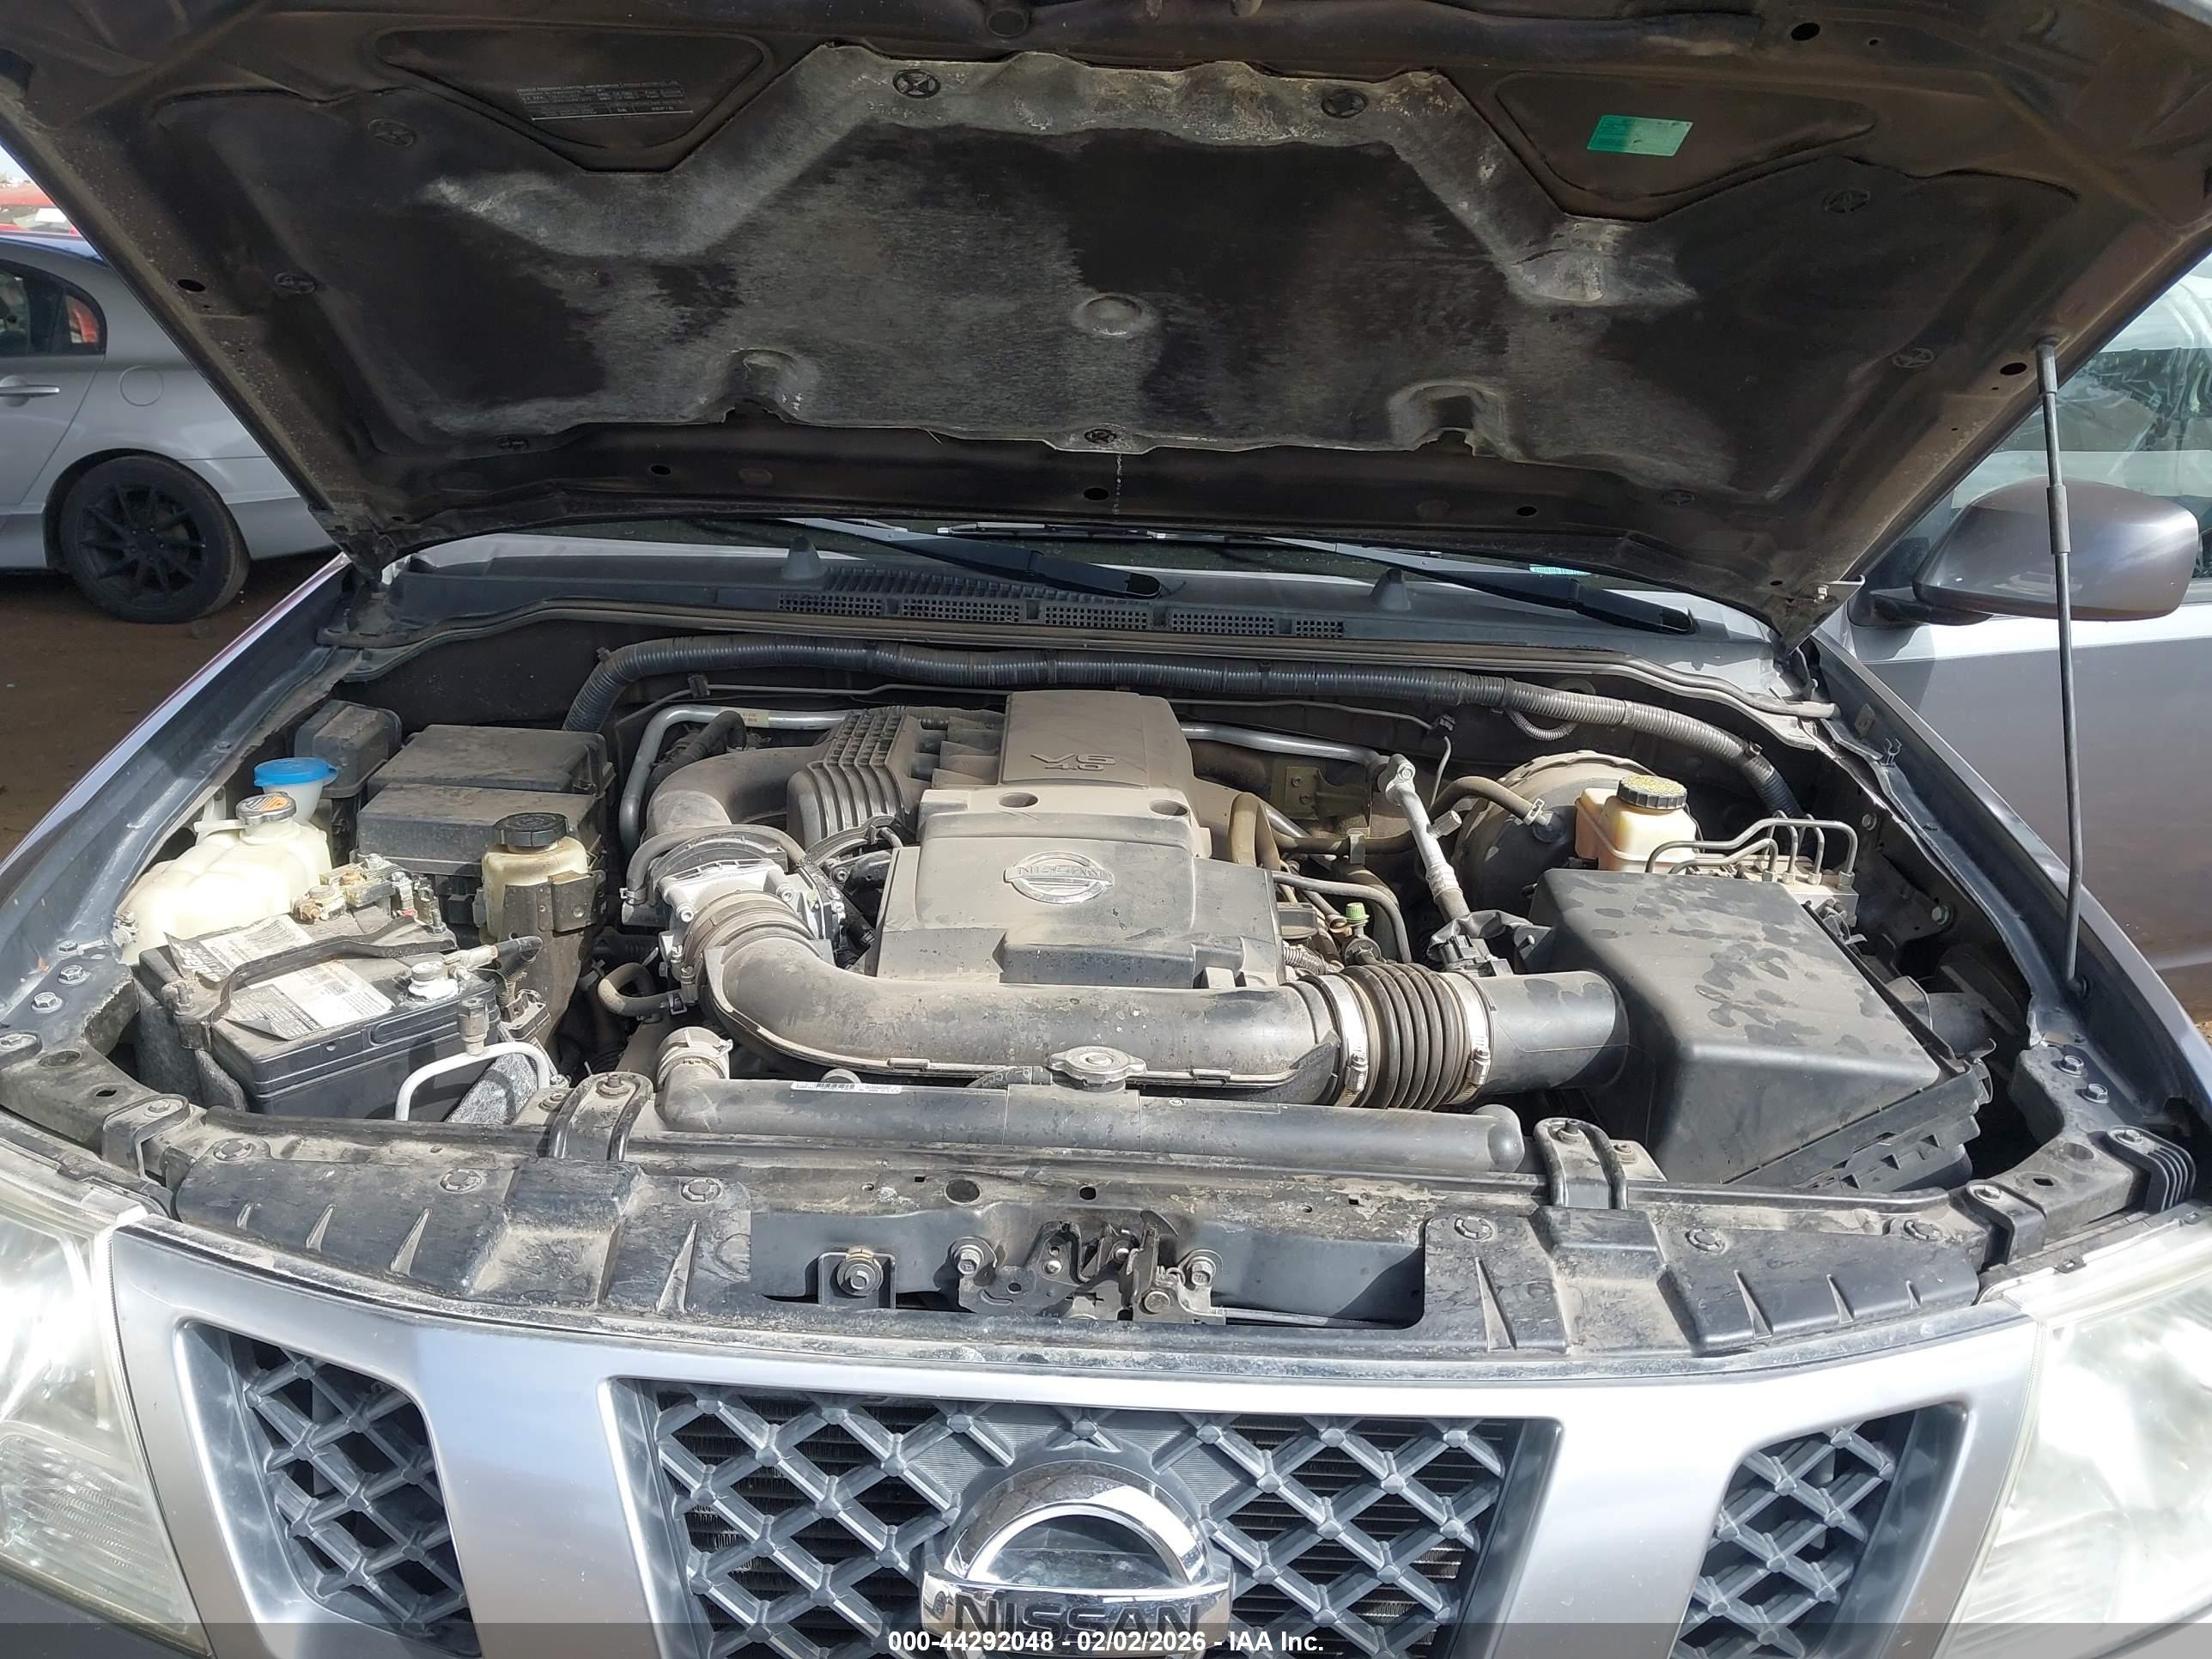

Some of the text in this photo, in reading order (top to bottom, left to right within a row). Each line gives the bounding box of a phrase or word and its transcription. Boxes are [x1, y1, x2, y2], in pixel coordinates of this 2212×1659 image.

[1030, 753, 1115, 765] V6
[1018, 865, 1103, 879] NISSAN
[954, 1591, 1199, 1643] NISSAN
